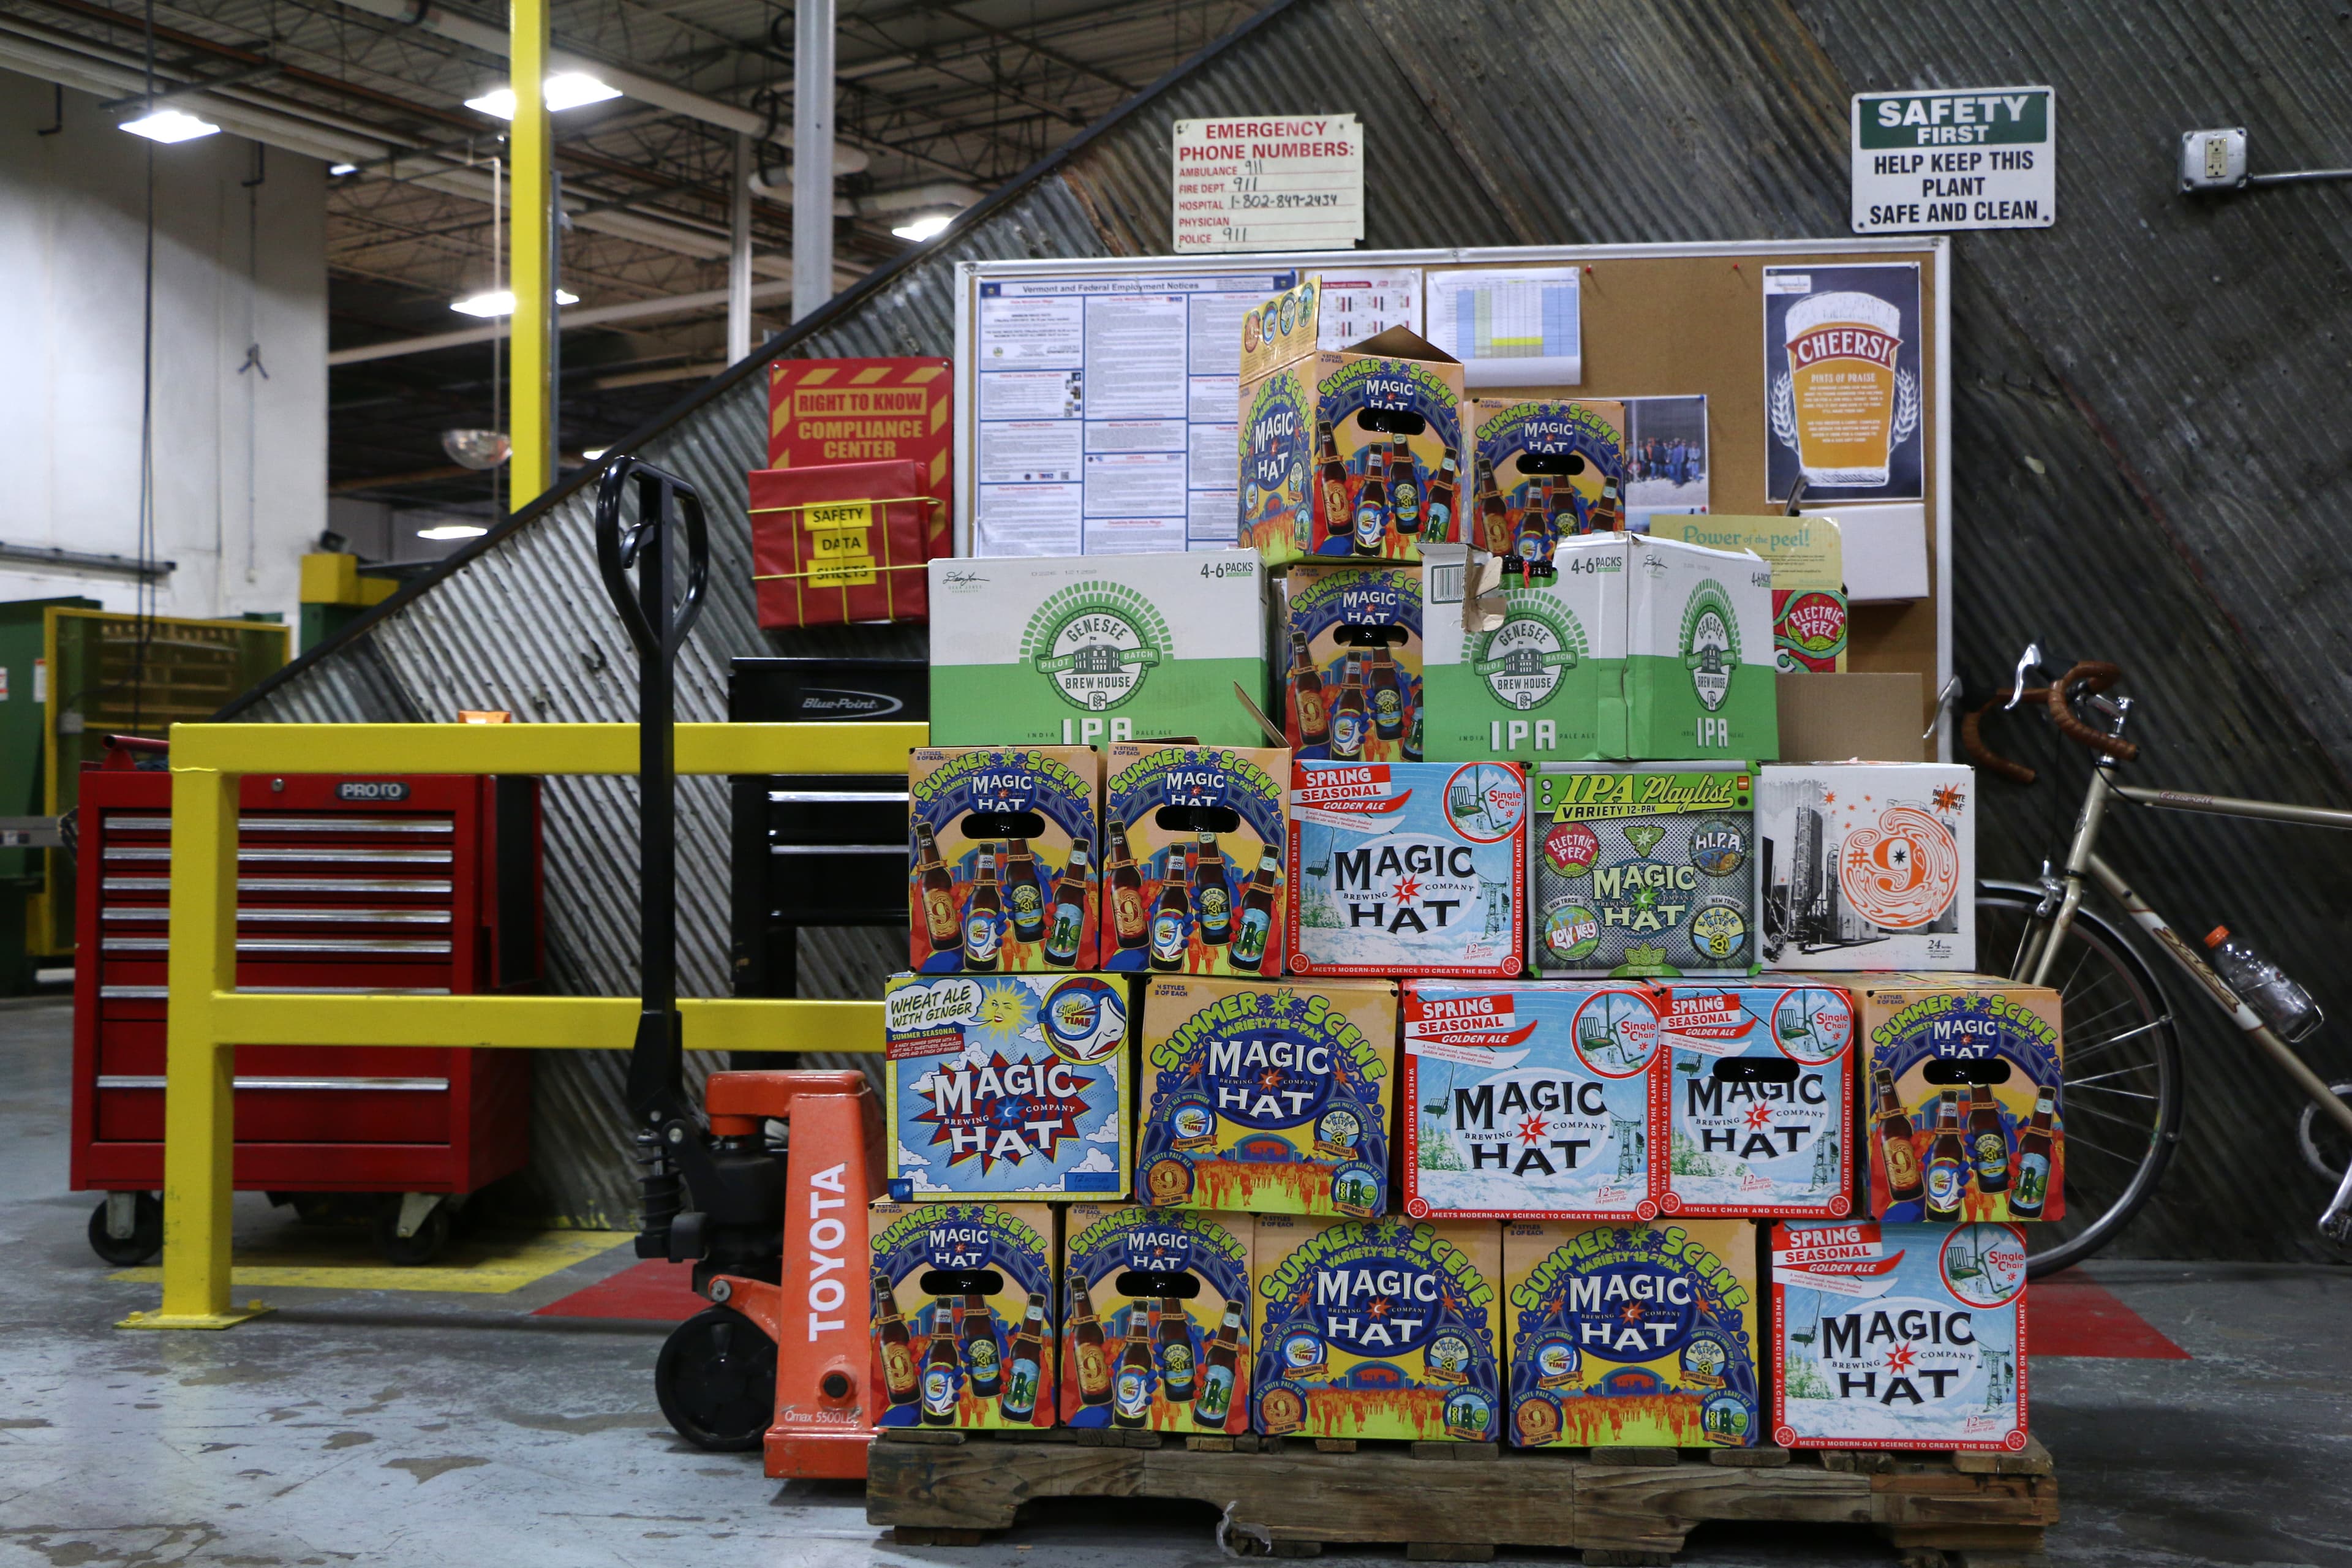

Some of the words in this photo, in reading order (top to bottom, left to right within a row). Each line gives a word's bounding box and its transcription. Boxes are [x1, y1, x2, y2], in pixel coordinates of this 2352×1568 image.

[1877, 96, 2029, 127] SAFETY
[1205, 121, 1327, 139] EMERGENCY
[1917, 125, 1989, 145] FIRST
[1179, 145, 1245, 161] PHONE
[1253, 141, 1354, 159] NUMBERS:
[1179, 166, 1237, 177] AMBULANCE
[1245, 159, 1263, 175] 911
[1874, 155, 1924, 175] HELP
[1931, 153, 1981, 172] KEEP
[1989, 151, 2034, 170] THIS
[1179, 185, 1199, 194] FIRE
[1233, 177, 1257, 192] 911
[1922, 177, 1985, 197] PLANT
[1179, 201, 1224, 211] HOSPITAL
[1870, 205, 1920, 224] SAFE
[1927, 202, 1967, 222] AND
[1974, 200, 2037, 221] CLEAN
[1179, 217, 1230, 227] PHYSICIAN
[1179, 235, 1212, 244] POLICE
[1223, 227, 1247, 242] 911
[1112, 282, 1164, 293] Employment
[1797, 331, 1891, 363] CHEERS!
[1317, 359, 1381, 397] SUMMER
[1408, 363, 1458, 408] SCENE
[1366, 380, 1414, 396] MAGIC
[798, 394, 846, 412] RIGHT
[849, 394, 868, 410] TO
[873, 393, 922, 410] KNOW
[1370, 399, 1408, 410] HAT
[798, 420, 923, 439] COMPLIANCE
[1255, 411, 1294, 454] MAGIC
[1524, 422, 1574, 437] MAGIC
[824, 441, 896, 459] CENTER
[1529, 441, 1567, 454] HAT
[1257, 454, 1289, 482] HAT
[813, 508, 863, 523] SAFETY
[822, 537, 861, 551] DATA
[1683, 525, 1741, 545] Power
[1743, 535, 1754, 546] of
[1755, 534, 1768, 543] the
[1771, 530, 1809, 551] peel!
[1200, 562, 1224, 579] 4-6
[1226, 562, 1254, 573] PACKS
[1570, 558, 1594, 575] 4-6
[1596, 556, 1622, 568] PACKS
[1343, 591, 1396, 608] MAGIC
[1347, 612, 1390, 625] HAT
[1790, 605, 1844, 626] ELECTRIC
[1066, 617, 1129, 643] GENESEE
[1499, 624, 1550, 647] GENESEE
[1799, 620, 1833, 638] PEEL
[1041, 658, 1069, 669] PILOT
[1124, 650, 1153, 660] BATCH
[1065, 677, 1095, 690] BREW
[1097, 676, 1131, 688] HOUSE
[1498, 677, 1521, 690] BREW
[1523, 677, 1551, 689] HOUSE
[1061, 717, 1132, 745] IPA
[1696, 718, 1728, 748] IPA
[912, 750, 991, 801] SUMMER
[1025, 750, 1091, 799] SCENE
[941, 775, 972, 794] VARIETY
[972, 774, 1033, 795] MAGIC
[1166, 772, 1224, 791] MAGIC
[1306, 767, 1371, 787] SPRING
[1171, 794, 1217, 806] HAT
[1301, 785, 1381, 801] SEASONAL
[1489, 790, 1521, 802] Single
[1561, 774, 1634, 804] IPA
[1640, 774, 1734, 814] Playlist
[978, 798, 1025, 813] HAT
[1323, 802, 1363, 810] GOLDEN
[1497, 799, 1520, 809] Chair
[1562, 805, 1623, 818] VARIETY
[1626, 805, 1656, 814] 12-PAK
[1333, 845, 1476, 891] MAGIC
[1343, 891, 1389, 900] BREWING
[1425, 883, 1475, 892] COMPANY
[1593, 865, 1697, 900] MAGIC
[1549, 900, 1560, 910] NEW
[1349, 899, 1460, 935] HAT
[1604, 905, 1686, 932] HAT
[1551, 926, 1575, 949] LOW
[1575, 921, 1597, 938] KEY
[1928, 940, 1941, 949] 24
[1465, 944, 1477, 954] 12
[891, 995, 938, 1014] WHEAT
[943, 986, 971, 1006] ALE
[1422, 998, 1494, 1019] SPRING
[892, 1012, 922, 1028] WITH
[925, 1002, 972, 1022] GINGER
[1064, 1016, 1091, 1027] TIME
[892, 1031, 920, 1040] SUMMER
[922, 1028, 956, 1036] SEASONAL
[1418, 1017, 1504, 1033] SEASONAL
[1933, 1020, 1997, 1040] MAGIC
[1150, 992, 1258, 1072] SUMMER
[1303, 995, 1387, 1083] SCENE
[1208, 1041, 1330, 1077] MAGIC
[1940, 1044, 1989, 1058] HAT
[932, 1063, 1077, 1116] MAGIC
[1218, 1087, 1314, 1119] HAT
[1453, 1080, 1608, 1130] MAGIC
[944, 1115, 989, 1125] BREWING
[950, 1120, 1063, 1160] HAT
[1702, 1126, 1811, 1159] HAT
[1470, 1139, 1590, 1177] HAT
[929, 1228, 989, 1248] MAGIC
[1128, 1232, 1188, 1251] MAGIC
[1790, 1227, 1861, 1248] SPRING
[808, 1163, 846, 1341] TOYOTA
[935, 1253, 981, 1267] HAT
[1785, 1246, 1871, 1263] SEASONAL
[1133, 1256, 1181, 1270] HAT
[1316, 1270, 1438, 1306] MAGIC
[1569, 1275, 1692, 1313] MAGIC
[1327, 1317, 1422, 1347] HAT
[1581, 1322, 1677, 1352] HAT
[1821, 1310, 1976, 1359] MAGIC
[1838, 1369, 1959, 1406] HAT
[785, 1411, 812, 1422] Qmax
